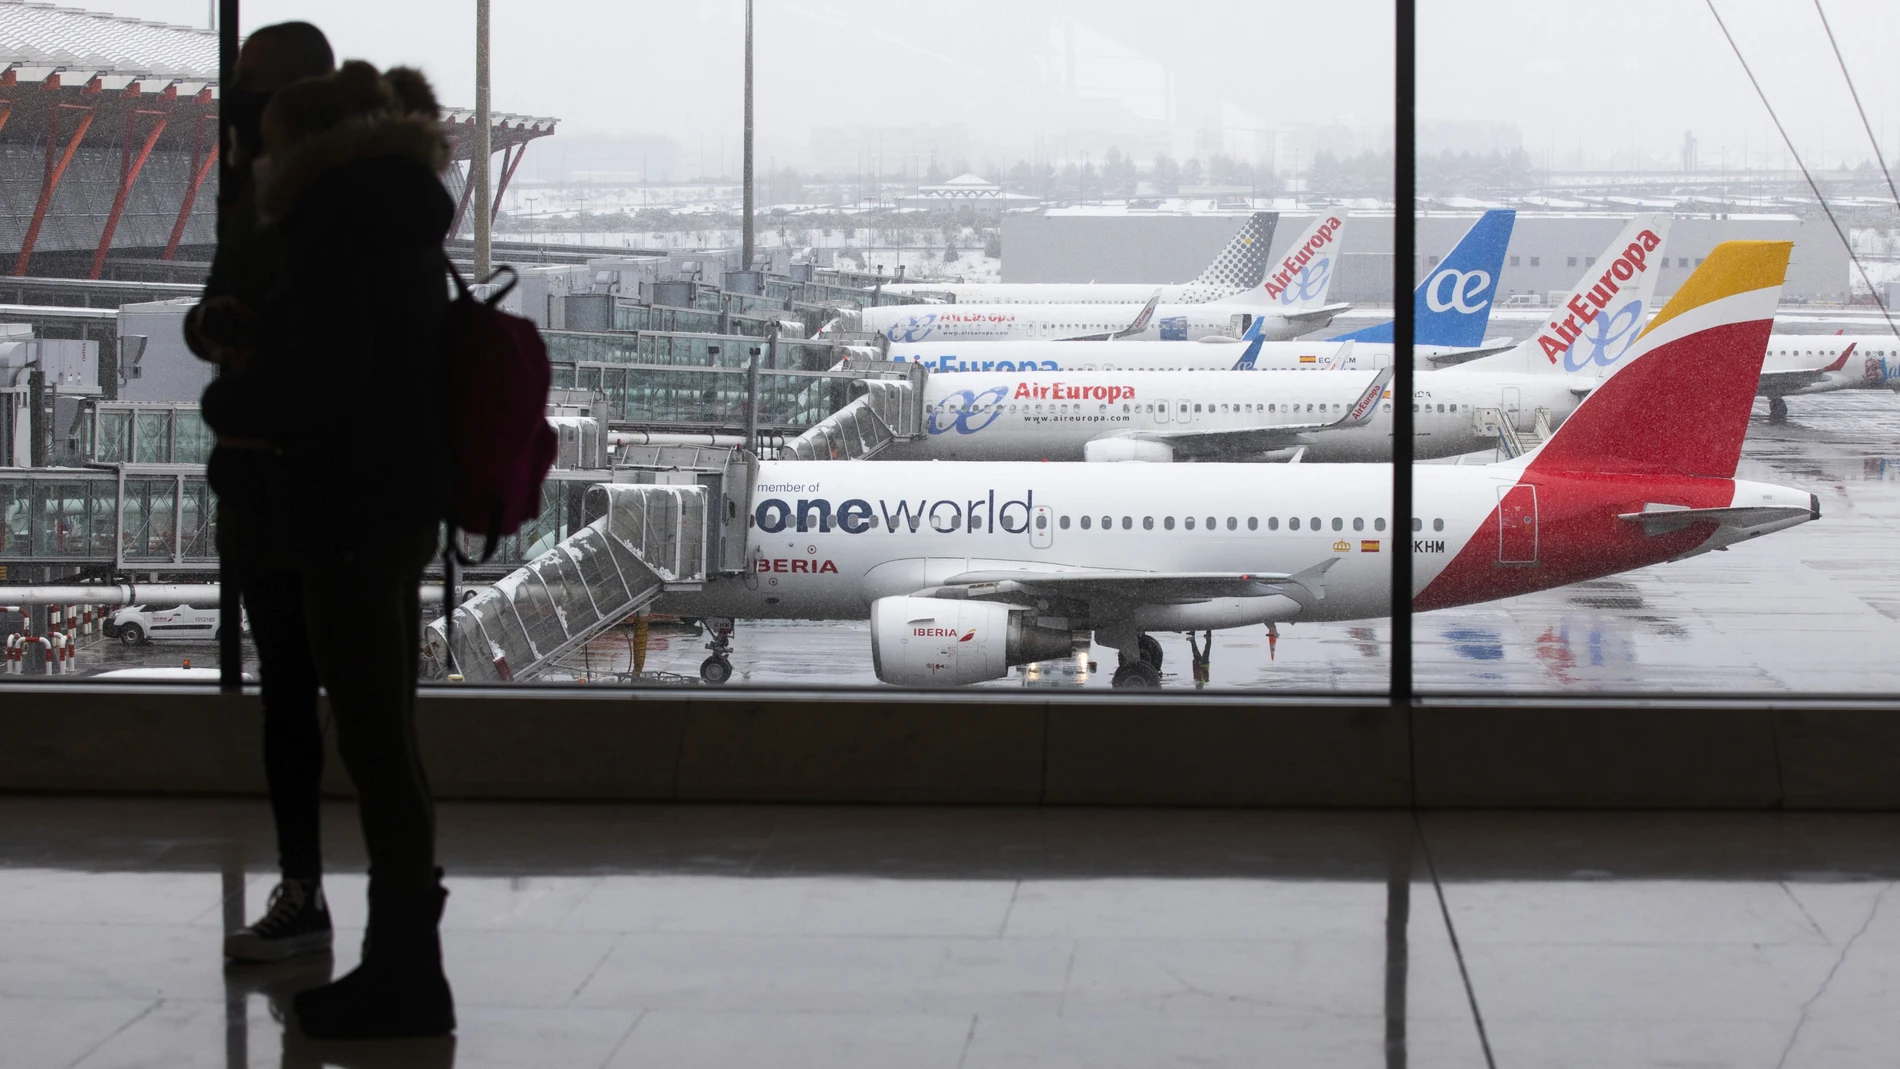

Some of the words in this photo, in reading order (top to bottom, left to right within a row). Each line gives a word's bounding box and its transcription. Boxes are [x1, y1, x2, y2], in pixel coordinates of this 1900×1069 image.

[1264, 216, 1342, 300] AirEuropa
[1537, 229, 1661, 365] AirEuropa
[893, 354, 1059, 373] rEuropa
[1014, 382, 1136, 404] AirEuropa
[1352, 385, 1381, 420] AirEuropa
[1024, 415, 1130, 424] www.aireuropa.com
[757, 483, 805, 492] member
[808, 483, 820, 492] of
[755, 489, 1033, 534] oneworld
[748, 559, 838, 573] BERIA
[913, 628, 957, 637] IBERIA
